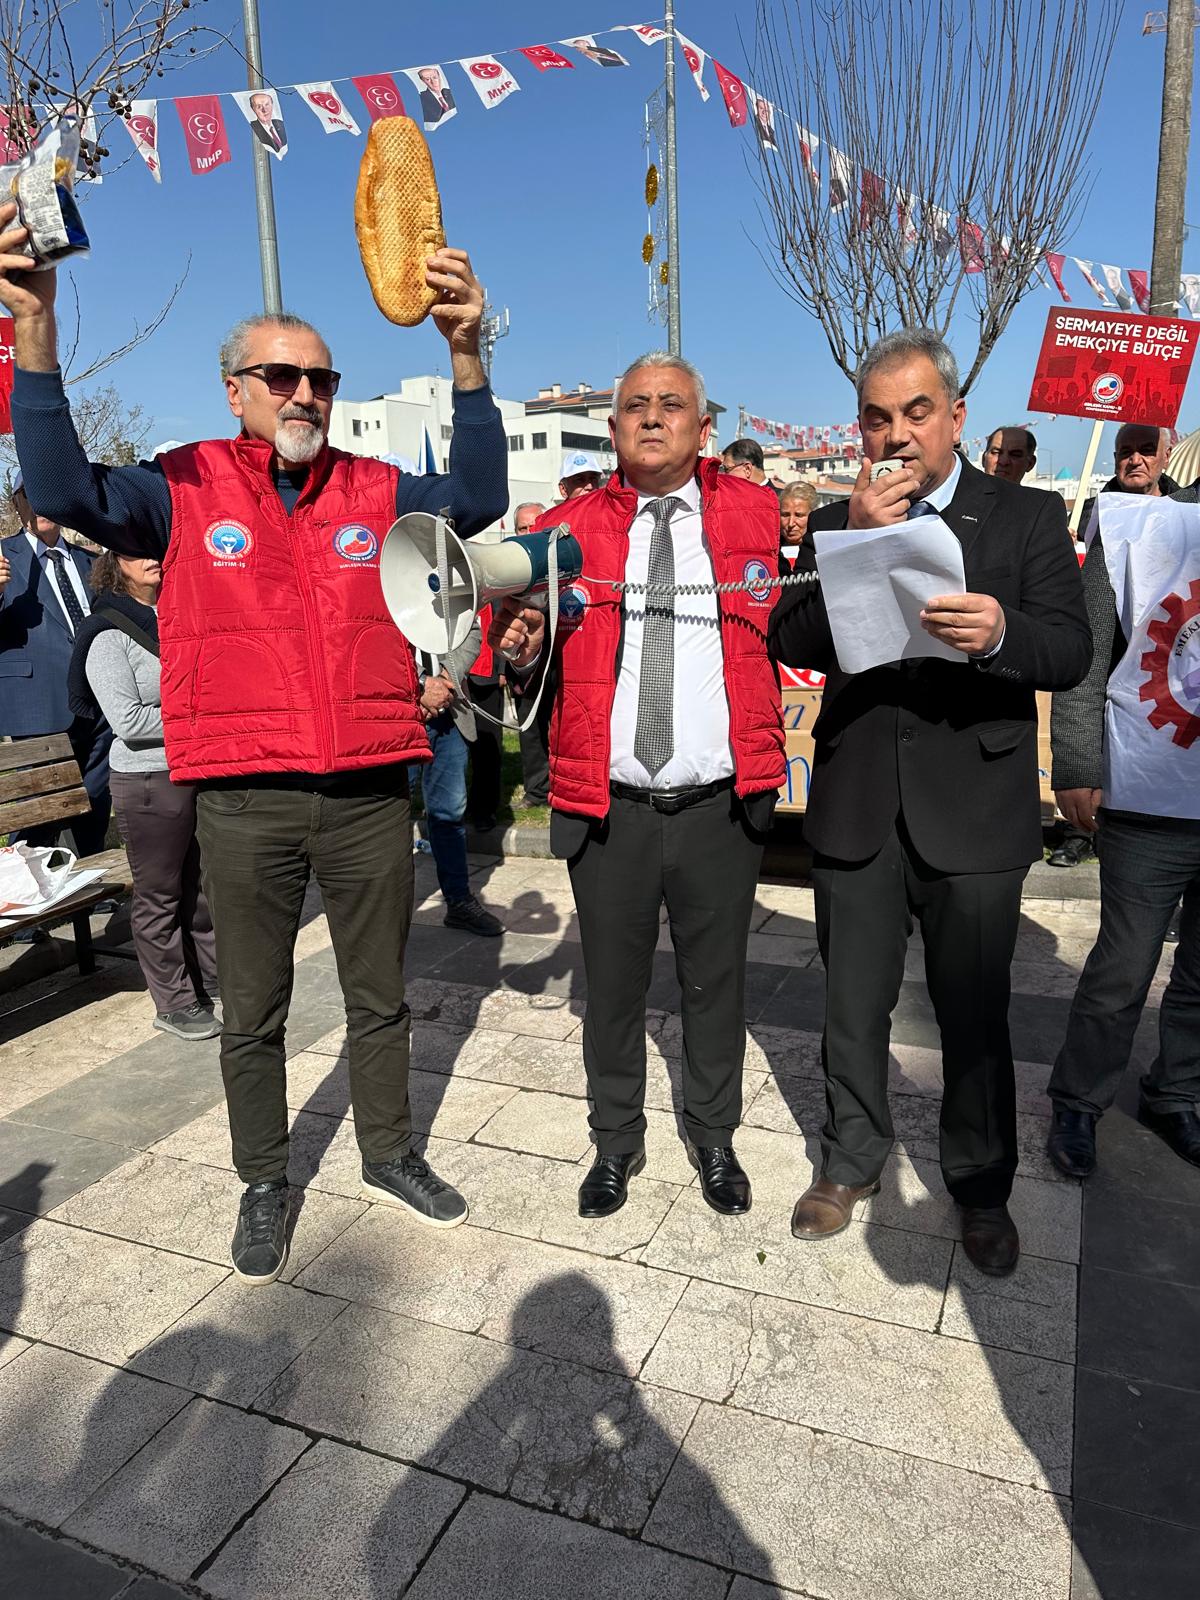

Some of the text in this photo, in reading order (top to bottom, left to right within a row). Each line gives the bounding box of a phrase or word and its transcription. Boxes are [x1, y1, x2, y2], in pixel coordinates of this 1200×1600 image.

[541, 60, 567, 68] MHP
[487, 80, 513, 100] MHP
[196, 149, 223, 169] MHP
[1055, 316, 1190, 342] SERMAYEYE DEĞİL
[1055, 334, 1182, 361] EMEKÇİYE BÜTÇE
